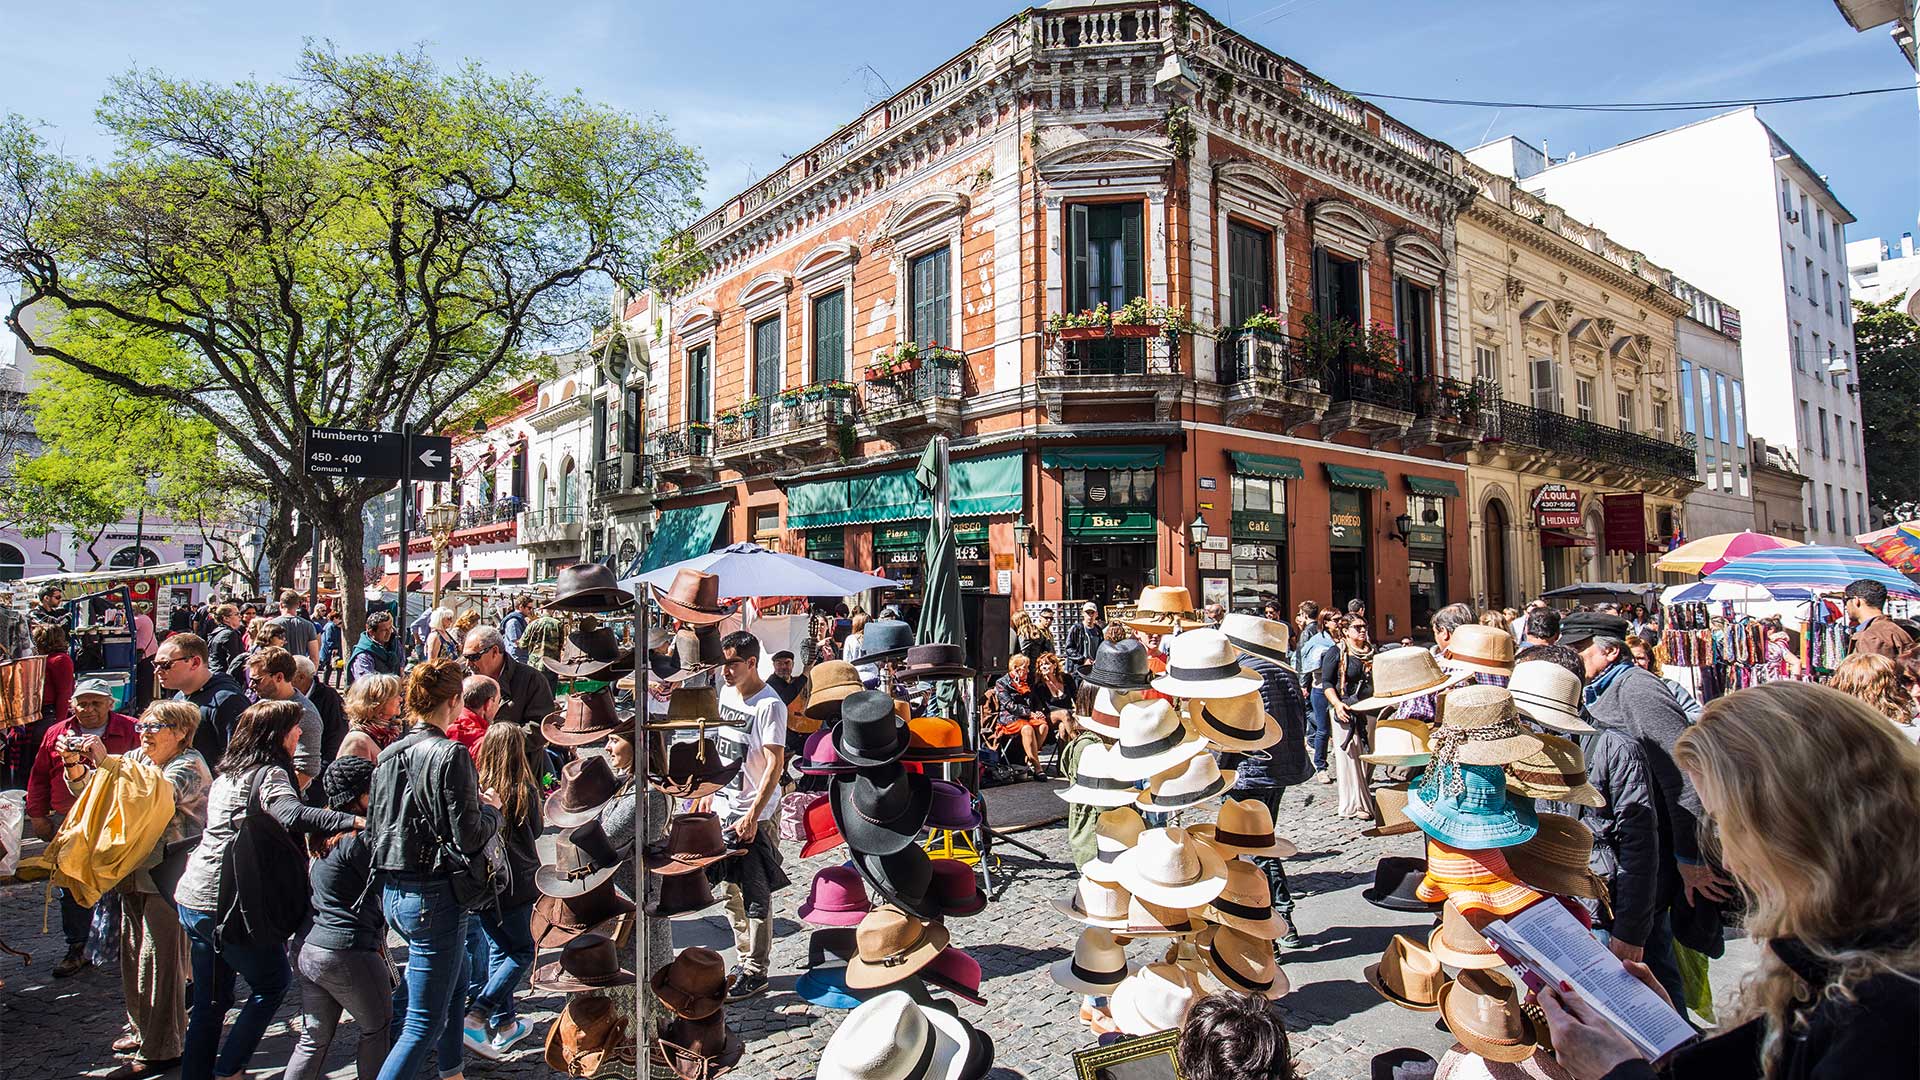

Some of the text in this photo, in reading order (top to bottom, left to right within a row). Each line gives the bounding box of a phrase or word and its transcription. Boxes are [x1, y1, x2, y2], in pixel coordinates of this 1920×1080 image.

[311, 429, 369, 442] Humberto
[311, 452, 332, 462] 450
[341, 454, 362, 464] 400
[310, 464, 342, 473] Comuna
[1541, 491, 1577, 500] LQUILA
[1091, 516, 1121, 527] Bar
[1248, 519, 1270, 532] Café
[1546, 516, 1580, 525] HILDA LEW
[1420, 533, 1433, 542] Bar
[890, 551, 918, 563] BAR
[1241, 546, 1268, 559] BAR
